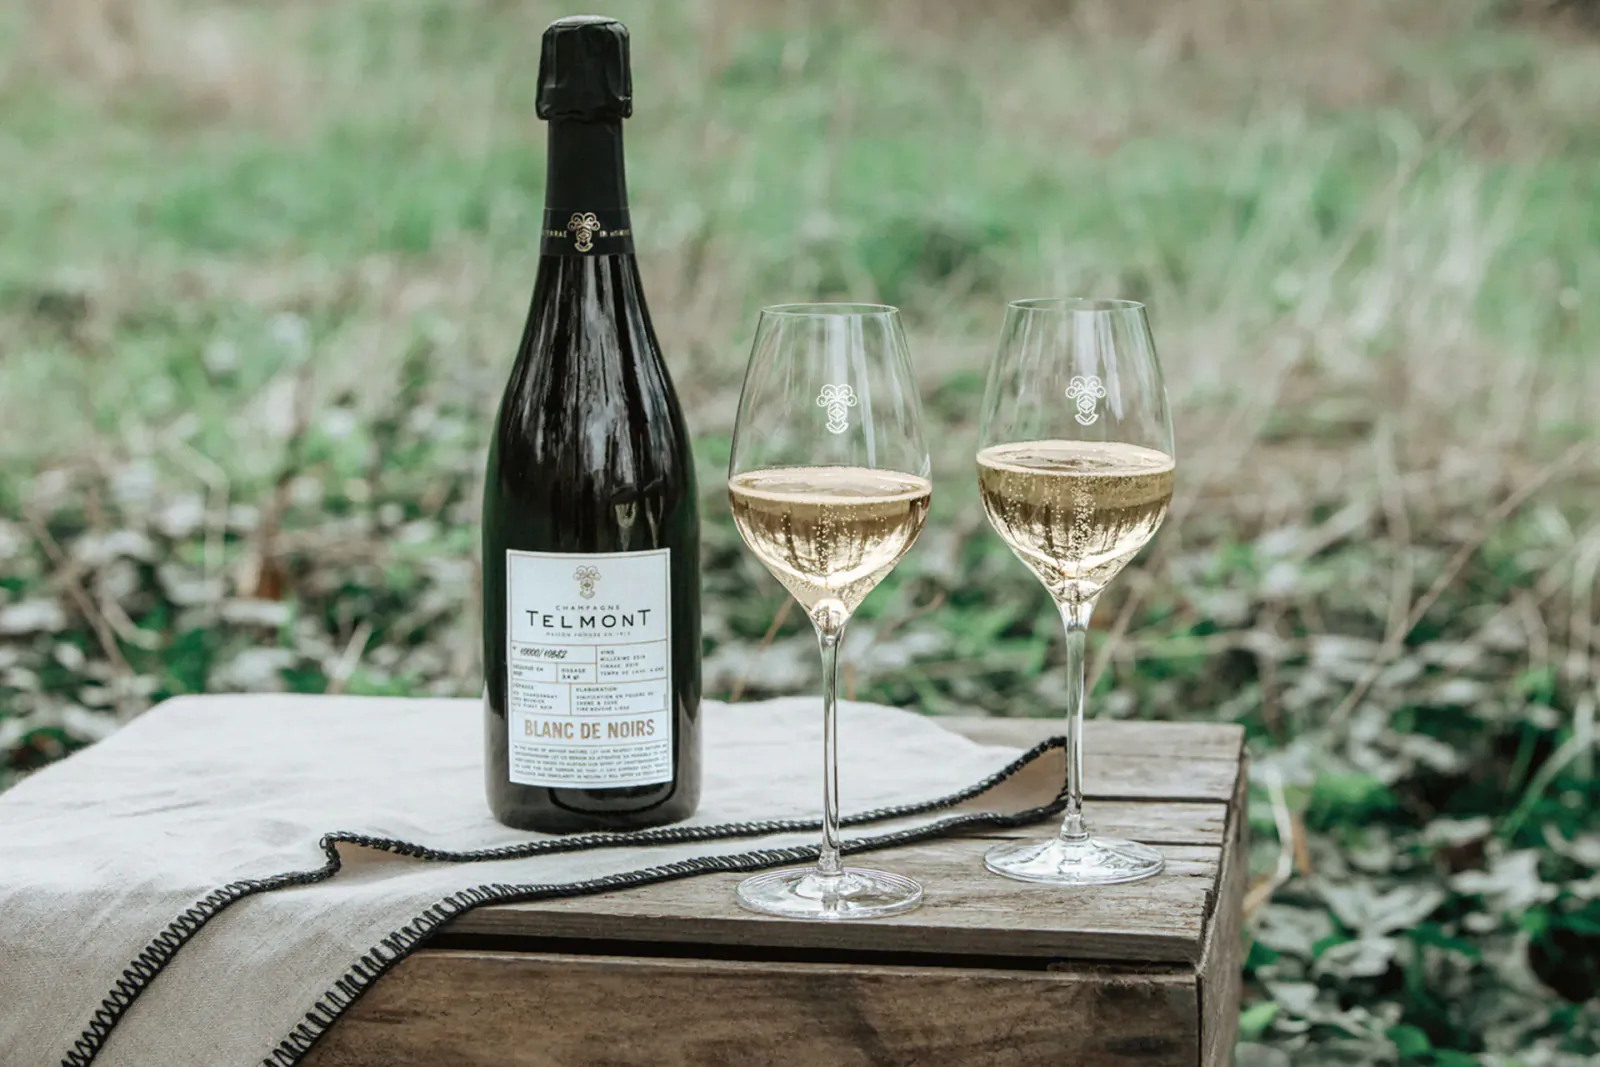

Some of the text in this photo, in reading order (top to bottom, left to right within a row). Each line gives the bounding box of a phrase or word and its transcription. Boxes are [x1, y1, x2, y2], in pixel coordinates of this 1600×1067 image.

[526, 609, 651, 628] TELMONT
[525, 719, 655, 739] BLANC DE NOIRS
